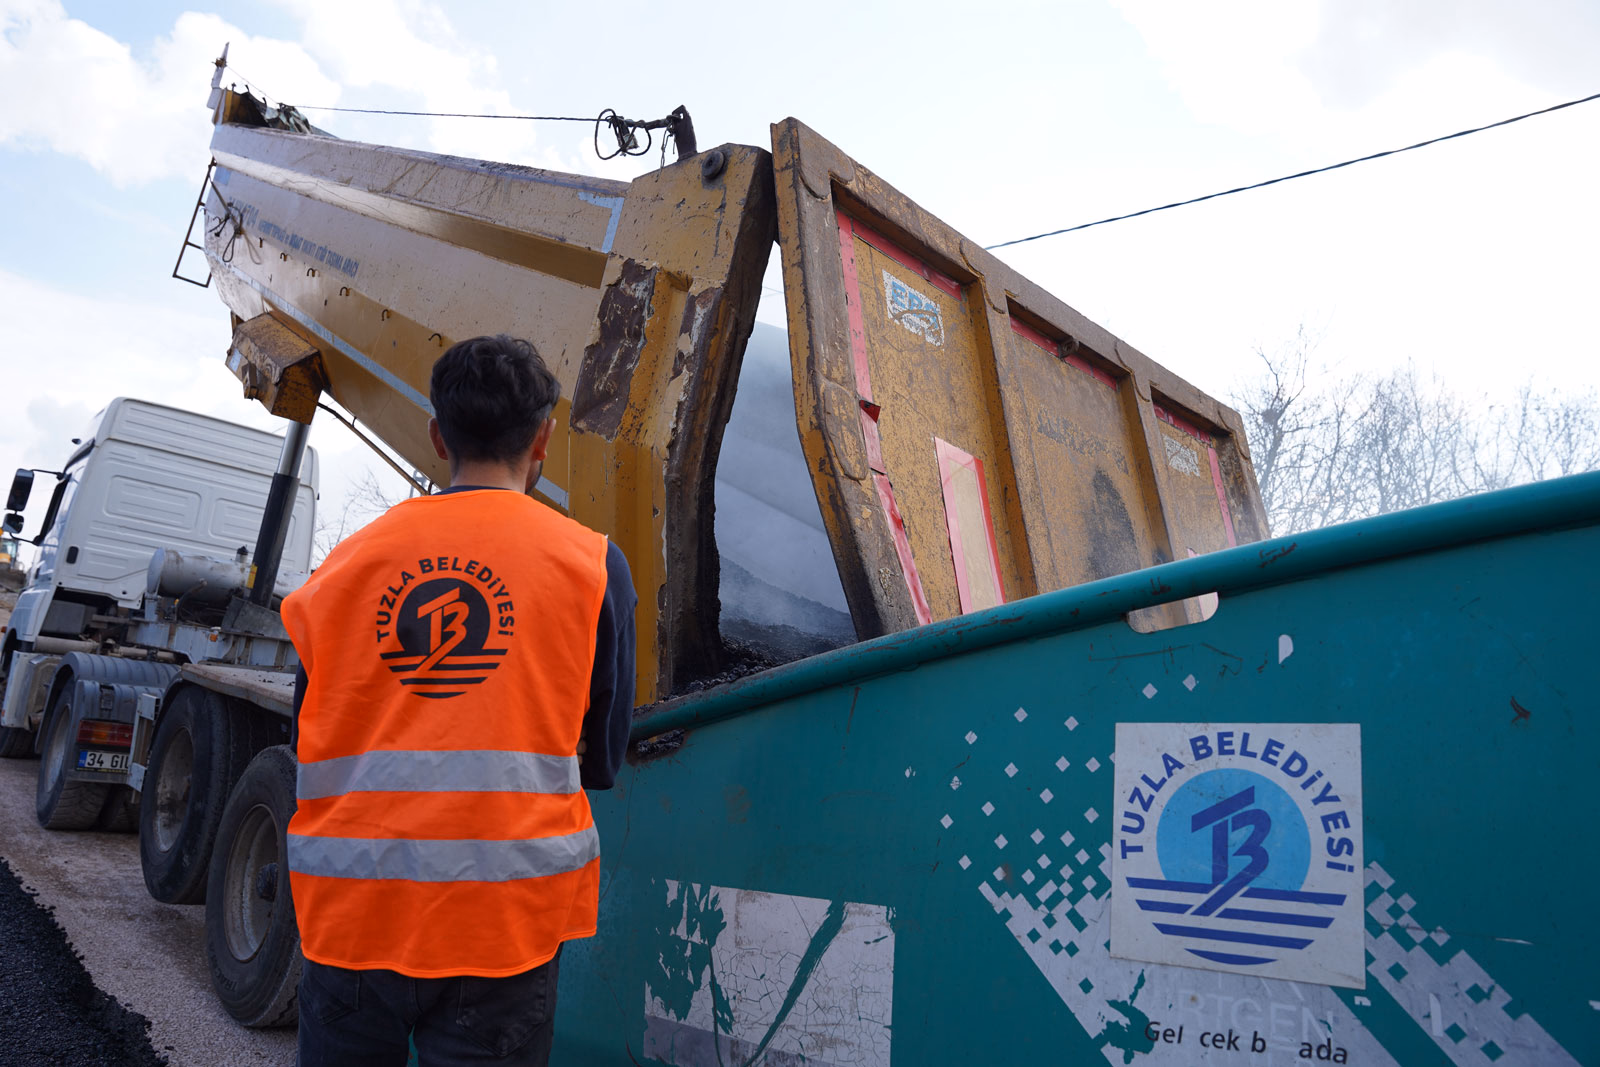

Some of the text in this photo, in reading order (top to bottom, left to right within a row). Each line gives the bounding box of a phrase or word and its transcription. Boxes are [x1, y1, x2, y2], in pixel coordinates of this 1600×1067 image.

[376, 570, 415, 643] TUZLA
[87, 753, 104, 767] 34
[1120, 752, 1185, 859] TUZLA
